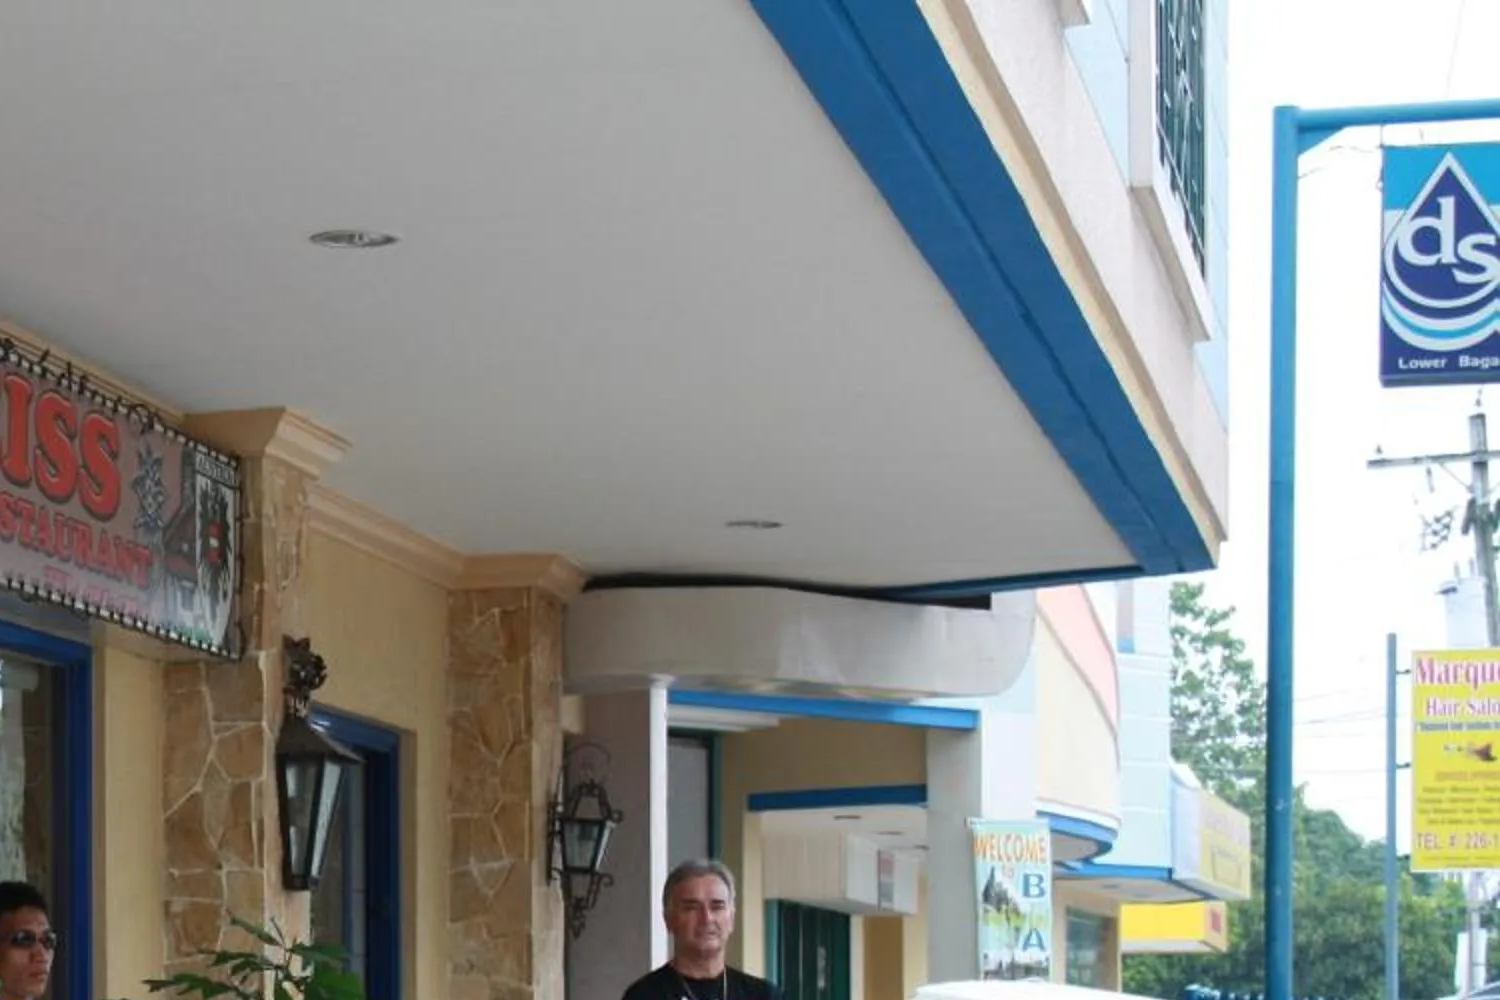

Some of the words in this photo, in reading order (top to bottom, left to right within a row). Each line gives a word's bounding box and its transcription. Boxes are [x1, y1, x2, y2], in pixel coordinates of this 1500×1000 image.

[1397, 196, 1500, 284] ds
[1398, 356, 1448, 369] Lower
[1415, 657, 1500, 690] Marqu
[1427, 697, 1460, 717] Hair
[973, 832, 1047, 864] WELCOME
